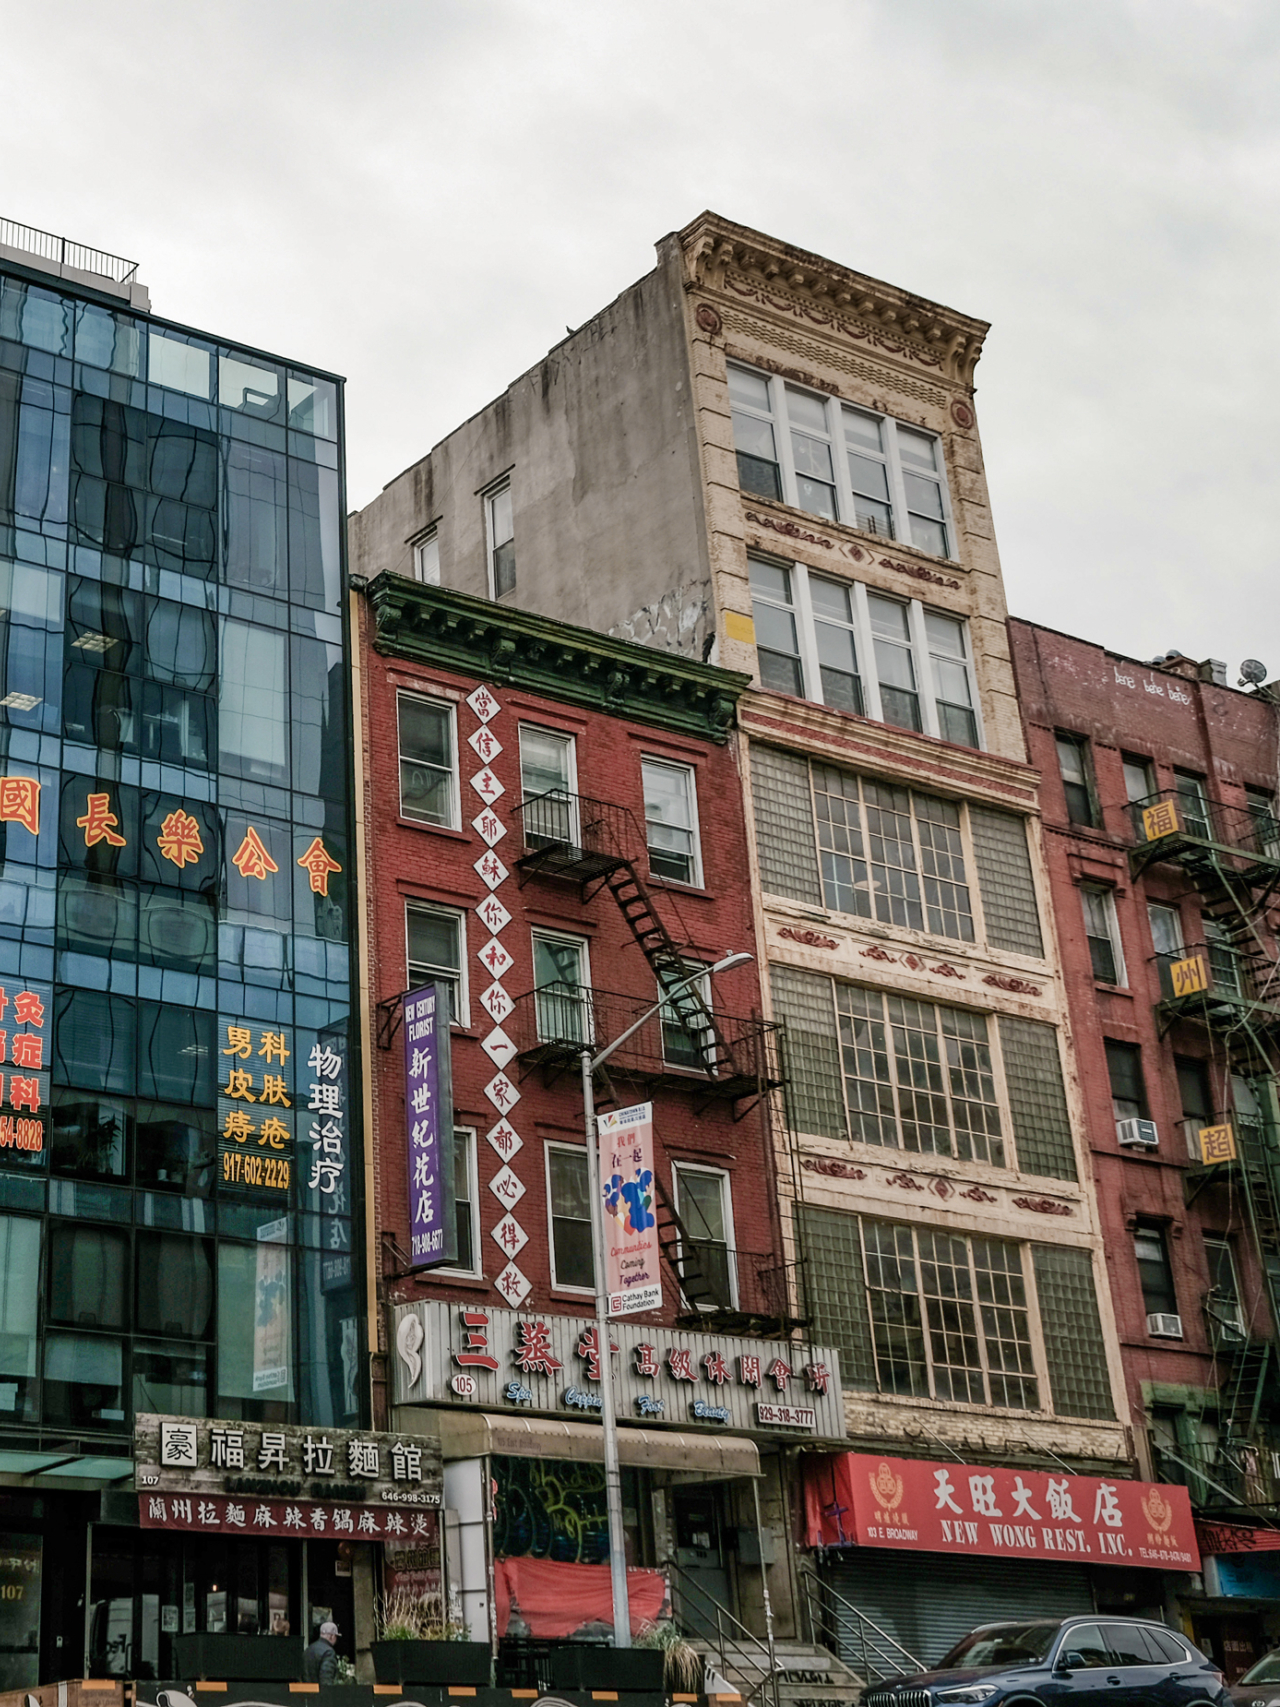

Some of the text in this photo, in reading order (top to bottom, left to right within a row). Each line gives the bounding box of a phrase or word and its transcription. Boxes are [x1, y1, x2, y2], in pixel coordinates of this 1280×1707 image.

[1147, 805, 1231, 1161] 福 州 超
[408, 1016, 433, 1043] FLORIST
[223, 1025, 291, 1067] 男科
[224, 1068, 292, 1108] 皮肤
[222, 1110, 291, 1149] 痔疮
[307, 1043, 344, 1194] 物理治疗
[408, 1047, 434, 1225] 新世紀花店
[223, 1151, 290, 1190] 917-602-2229
[621, 1258, 645, 1270] Coming
[619, 1271, 650, 1287] Together
[622, 1288, 659, 1303] Cathay Bank
[622, 1298, 655, 1311] Foundation
[455, 1377, 473, 1394] 105
[506, 1381, 533, 1404] Spa
[638, 1393, 665, 1416] Foot
[693, 1399, 731, 1424] Beauty
[758, 1405, 814, 1426] 929-318-3777
[141, 1475, 160, 1486] 107
[381, 1491, 441, 1505] 646-998-3175
[933, 1468, 1123, 1528] 天旺大飯店
[867, 1526, 918, 1541] 103 E. BROADWAY
[940, 1519, 1134, 1557] NEW WONG REST. INC.
[1, 1585, 24, 1600] 107
